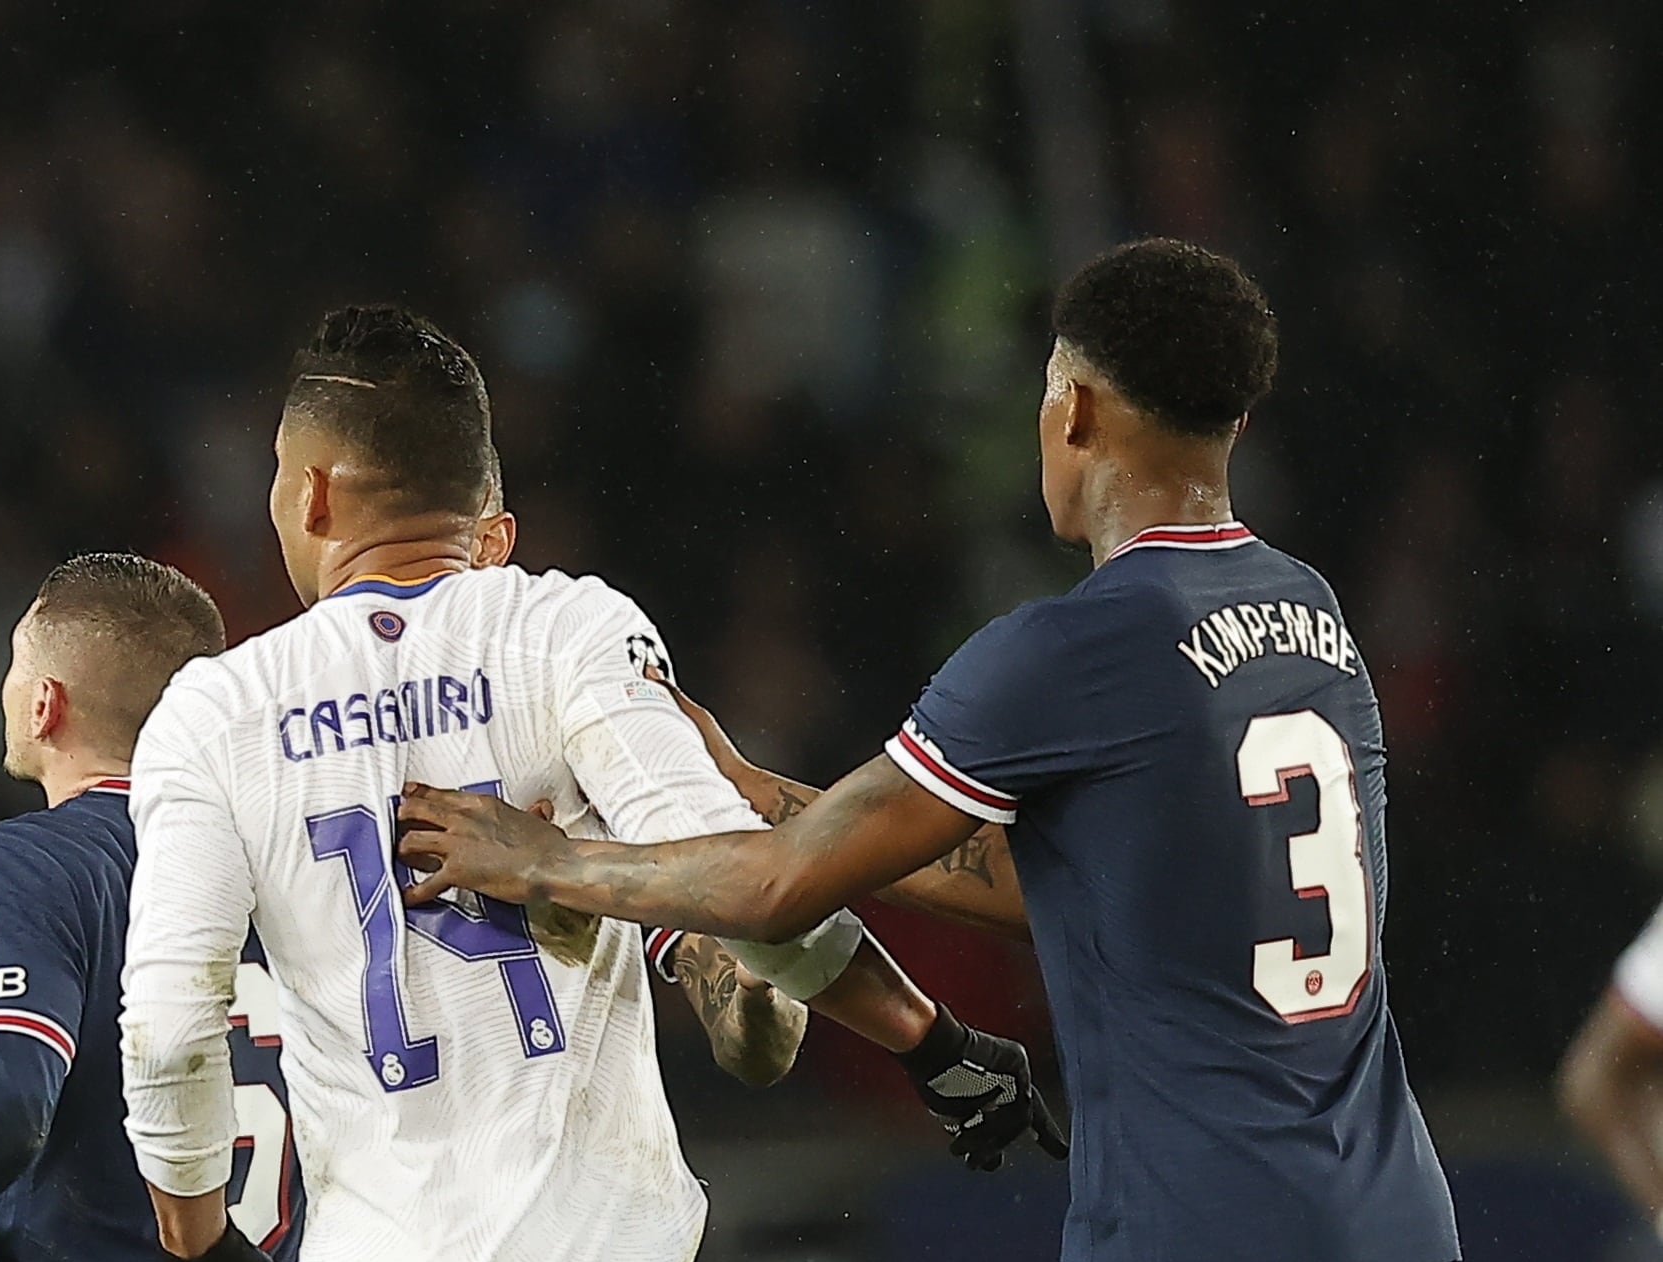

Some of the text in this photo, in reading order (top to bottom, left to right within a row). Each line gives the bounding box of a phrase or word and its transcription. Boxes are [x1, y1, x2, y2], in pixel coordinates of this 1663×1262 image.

[1178, 600, 1358, 688] KIMPEMBE
[305, 779, 565, 1093] 14
[1237, 710, 1373, 1025] 3
